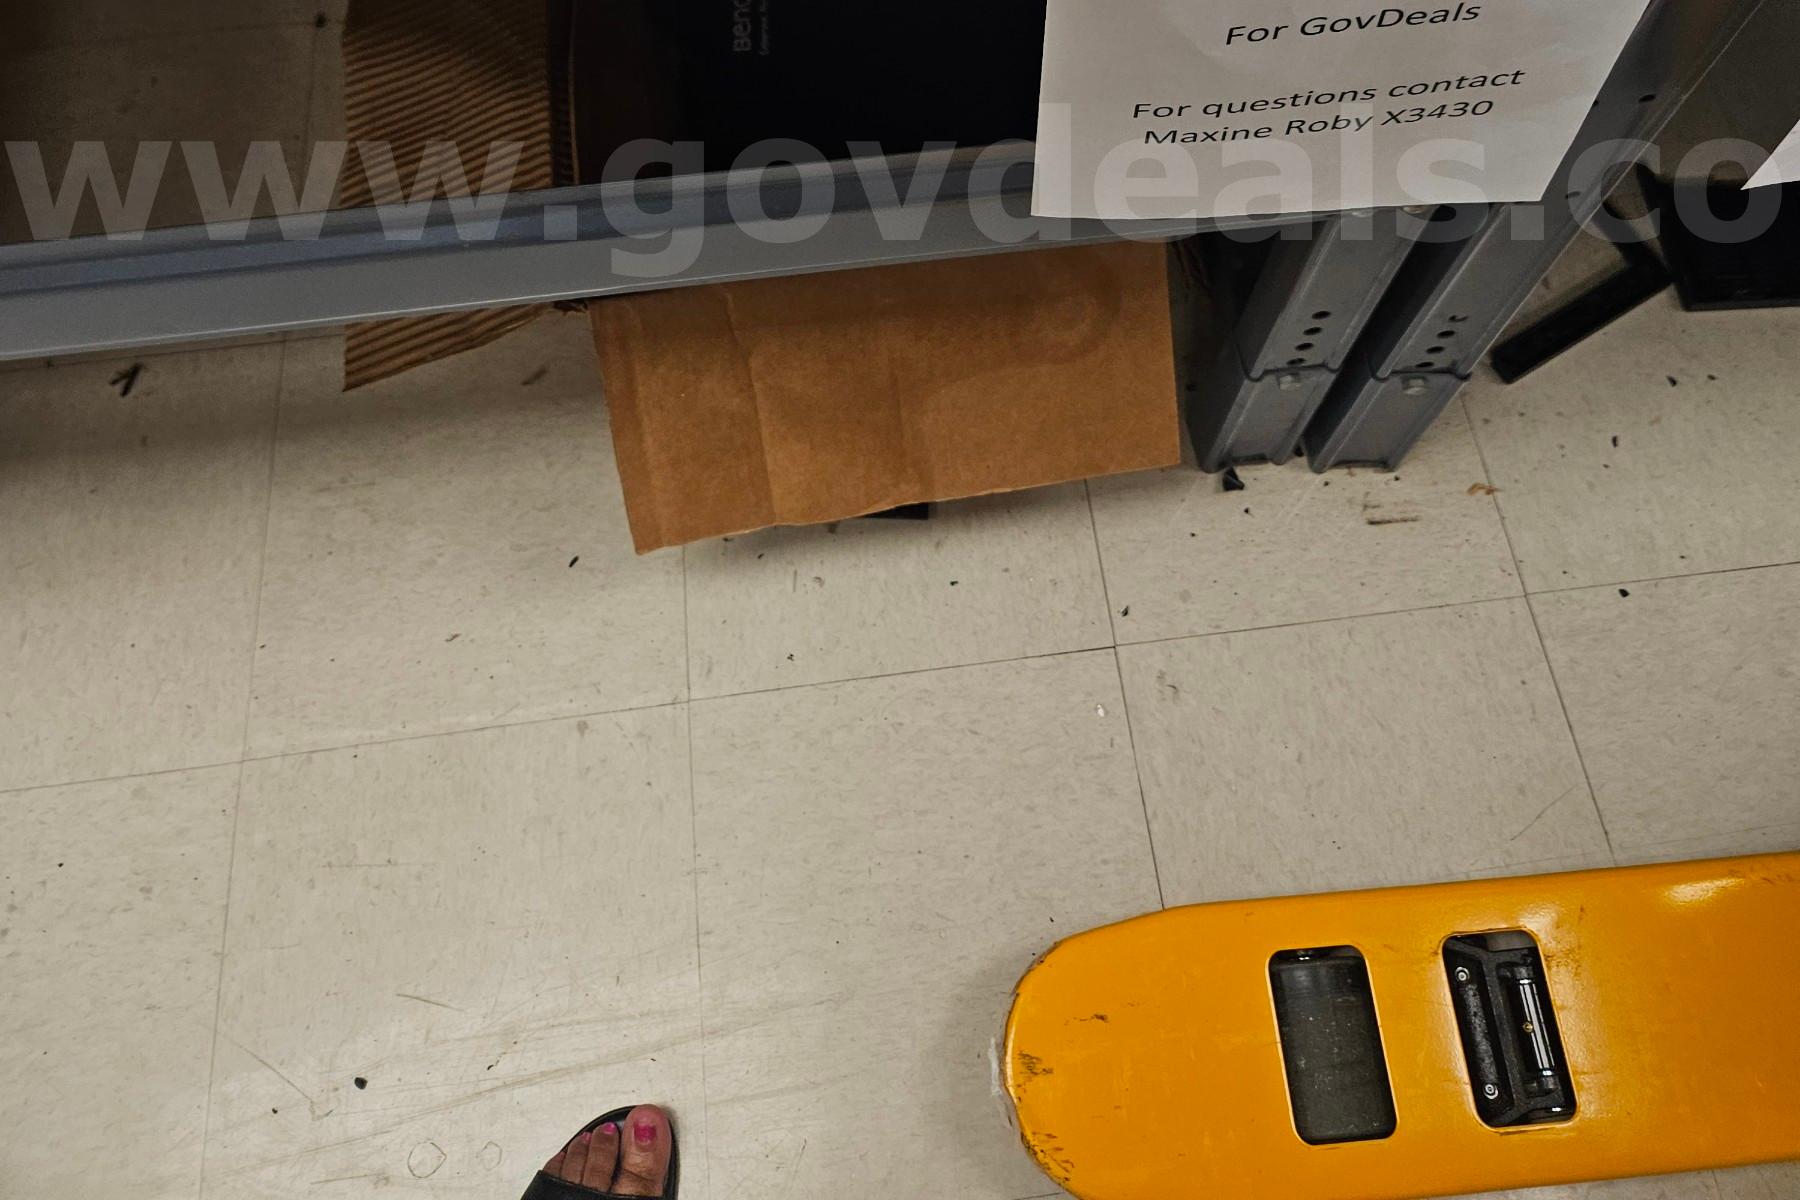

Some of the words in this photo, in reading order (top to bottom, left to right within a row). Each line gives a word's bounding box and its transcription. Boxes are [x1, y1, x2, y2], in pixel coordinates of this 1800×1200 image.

[1225, 23, 1289, 46] For
[1299, 2, 1482, 37] GovDeals
[1133, 102, 1192, 119] For
[1202, 84, 1377, 118] questions
[1388, 69, 1526, 99] contact
[1143, 122, 1273, 145] Maxine
[1285, 111, 1374, 136] Roby
[1380, 100, 1494, 126] X3430
